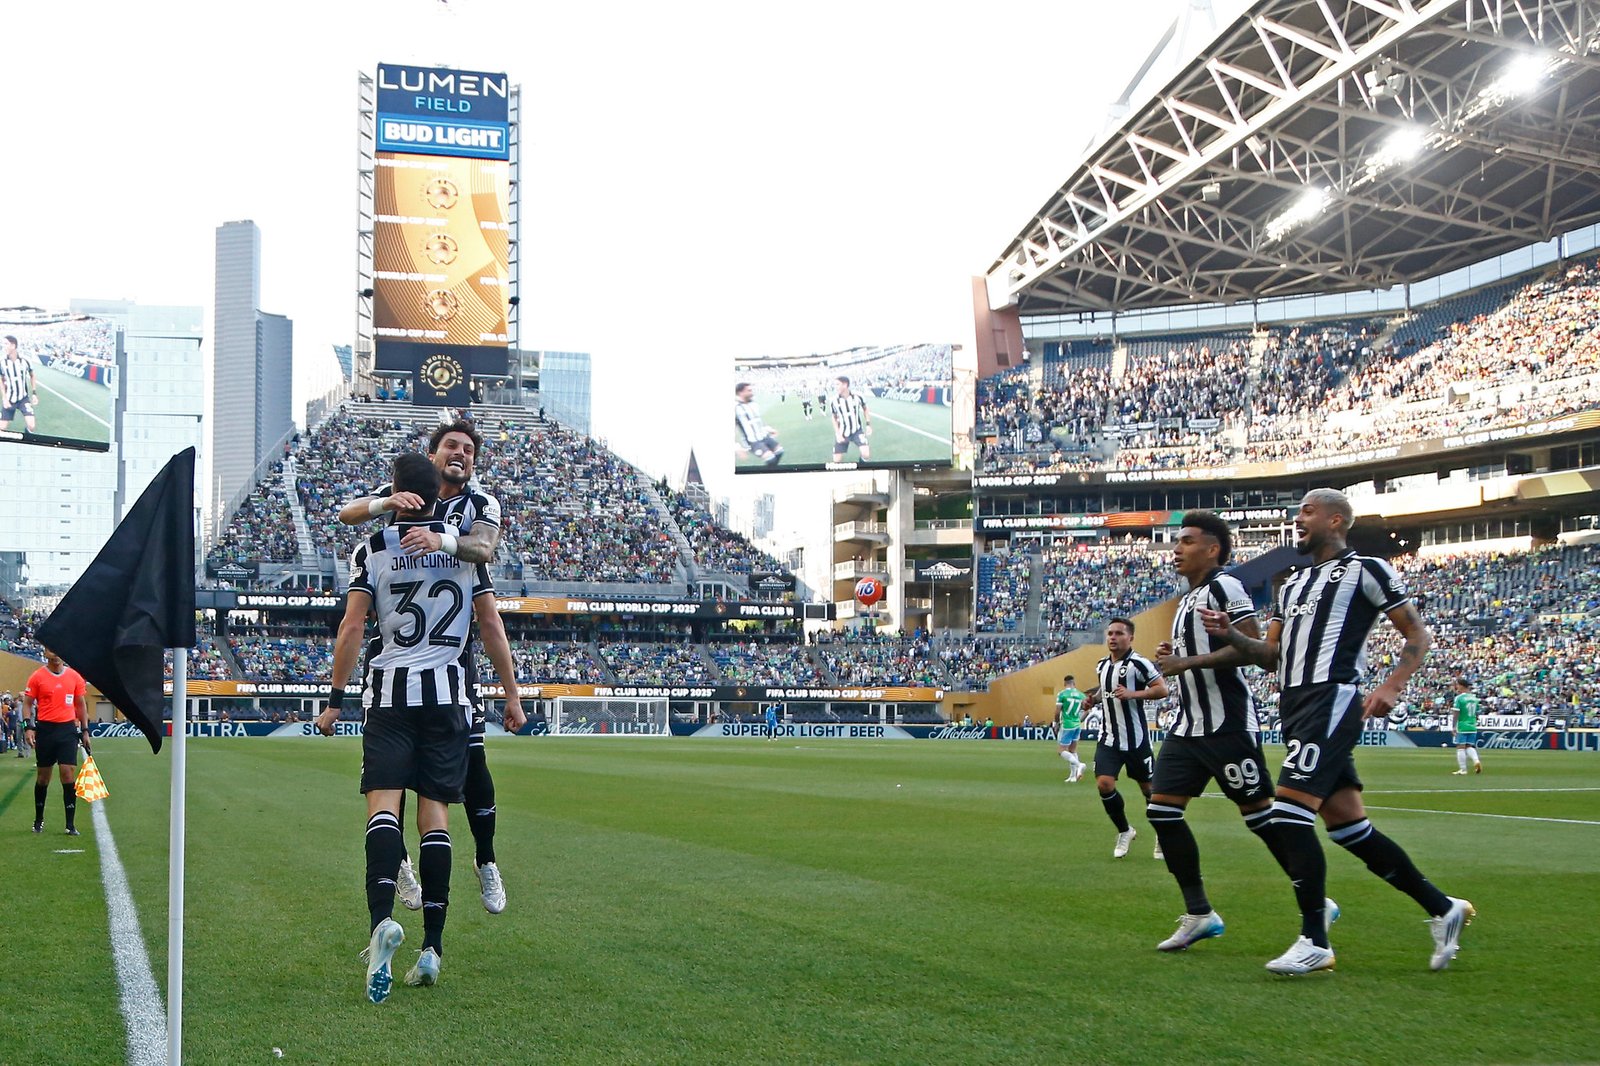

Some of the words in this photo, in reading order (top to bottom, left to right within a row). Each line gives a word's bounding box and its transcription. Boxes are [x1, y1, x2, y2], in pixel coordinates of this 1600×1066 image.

[379, 68, 507, 98] LUMEN
[415, 96, 472, 113] FIELD
[385, 122, 433, 142] BUD
[426, 354, 452, 364] WORLD
[1153, 469, 1188, 480] WORLD
[979, 477, 1012, 487] WORLD
[1013, 476, 1032, 485] CUP
[1220, 511, 1245, 520] CLUB
[1245, 509, 1281, 519] WORLD
[983, 519, 1002, 528] FIFA
[1003, 518, 1027, 528] CLUB
[1027, 517, 1061, 527] WORLD
[1061, 517, 1080, 525] CUP
[422, 554, 460, 569] CUNHA
[857, 582, 875, 596] 76
[248, 596, 287, 605] WORLD
[288, 596, 309, 606] CUP
[567, 602, 588, 611] FIFA
[590, 602, 614, 612] CLUB
[615, 602, 650, 613] WORLD
[652, 603, 670, 613] CUP
[389, 579, 464, 648] 32
[740, 606, 759, 615] FIFA
[761, 606, 783, 616] CLUB
[237, 684, 257, 693] FIFA
[258, 684, 282, 693] CLUB
[284, 684, 318, 693] WORLD
[319, 685, 332, 693] CU
[594, 687, 613, 696] FIFA
[614, 687, 638, 696] CLUB
[639, 687, 670, 696] WORLD
[671, 688, 689, 697] CUP
[766, 689, 785, 698] FIFA
[786, 689, 808, 698] CLUB
[809, 689, 841, 698] WORLD
[842, 690, 860, 698] CUP
[1066, 698, 1082, 716] 77
[1503, 717, 1524, 727] AMA
[722, 724, 795, 736] SUPEROR
[801, 725, 845, 737] LIGHT
[850, 725, 884, 738] BEER
[929, 725, 988, 739] Michelob
[1002, 727, 1056, 740] ULTRA
[1476, 730, 1545, 749] Michelob
[1282, 739, 1320, 772] 20
[1224, 758, 1260, 790] 99
